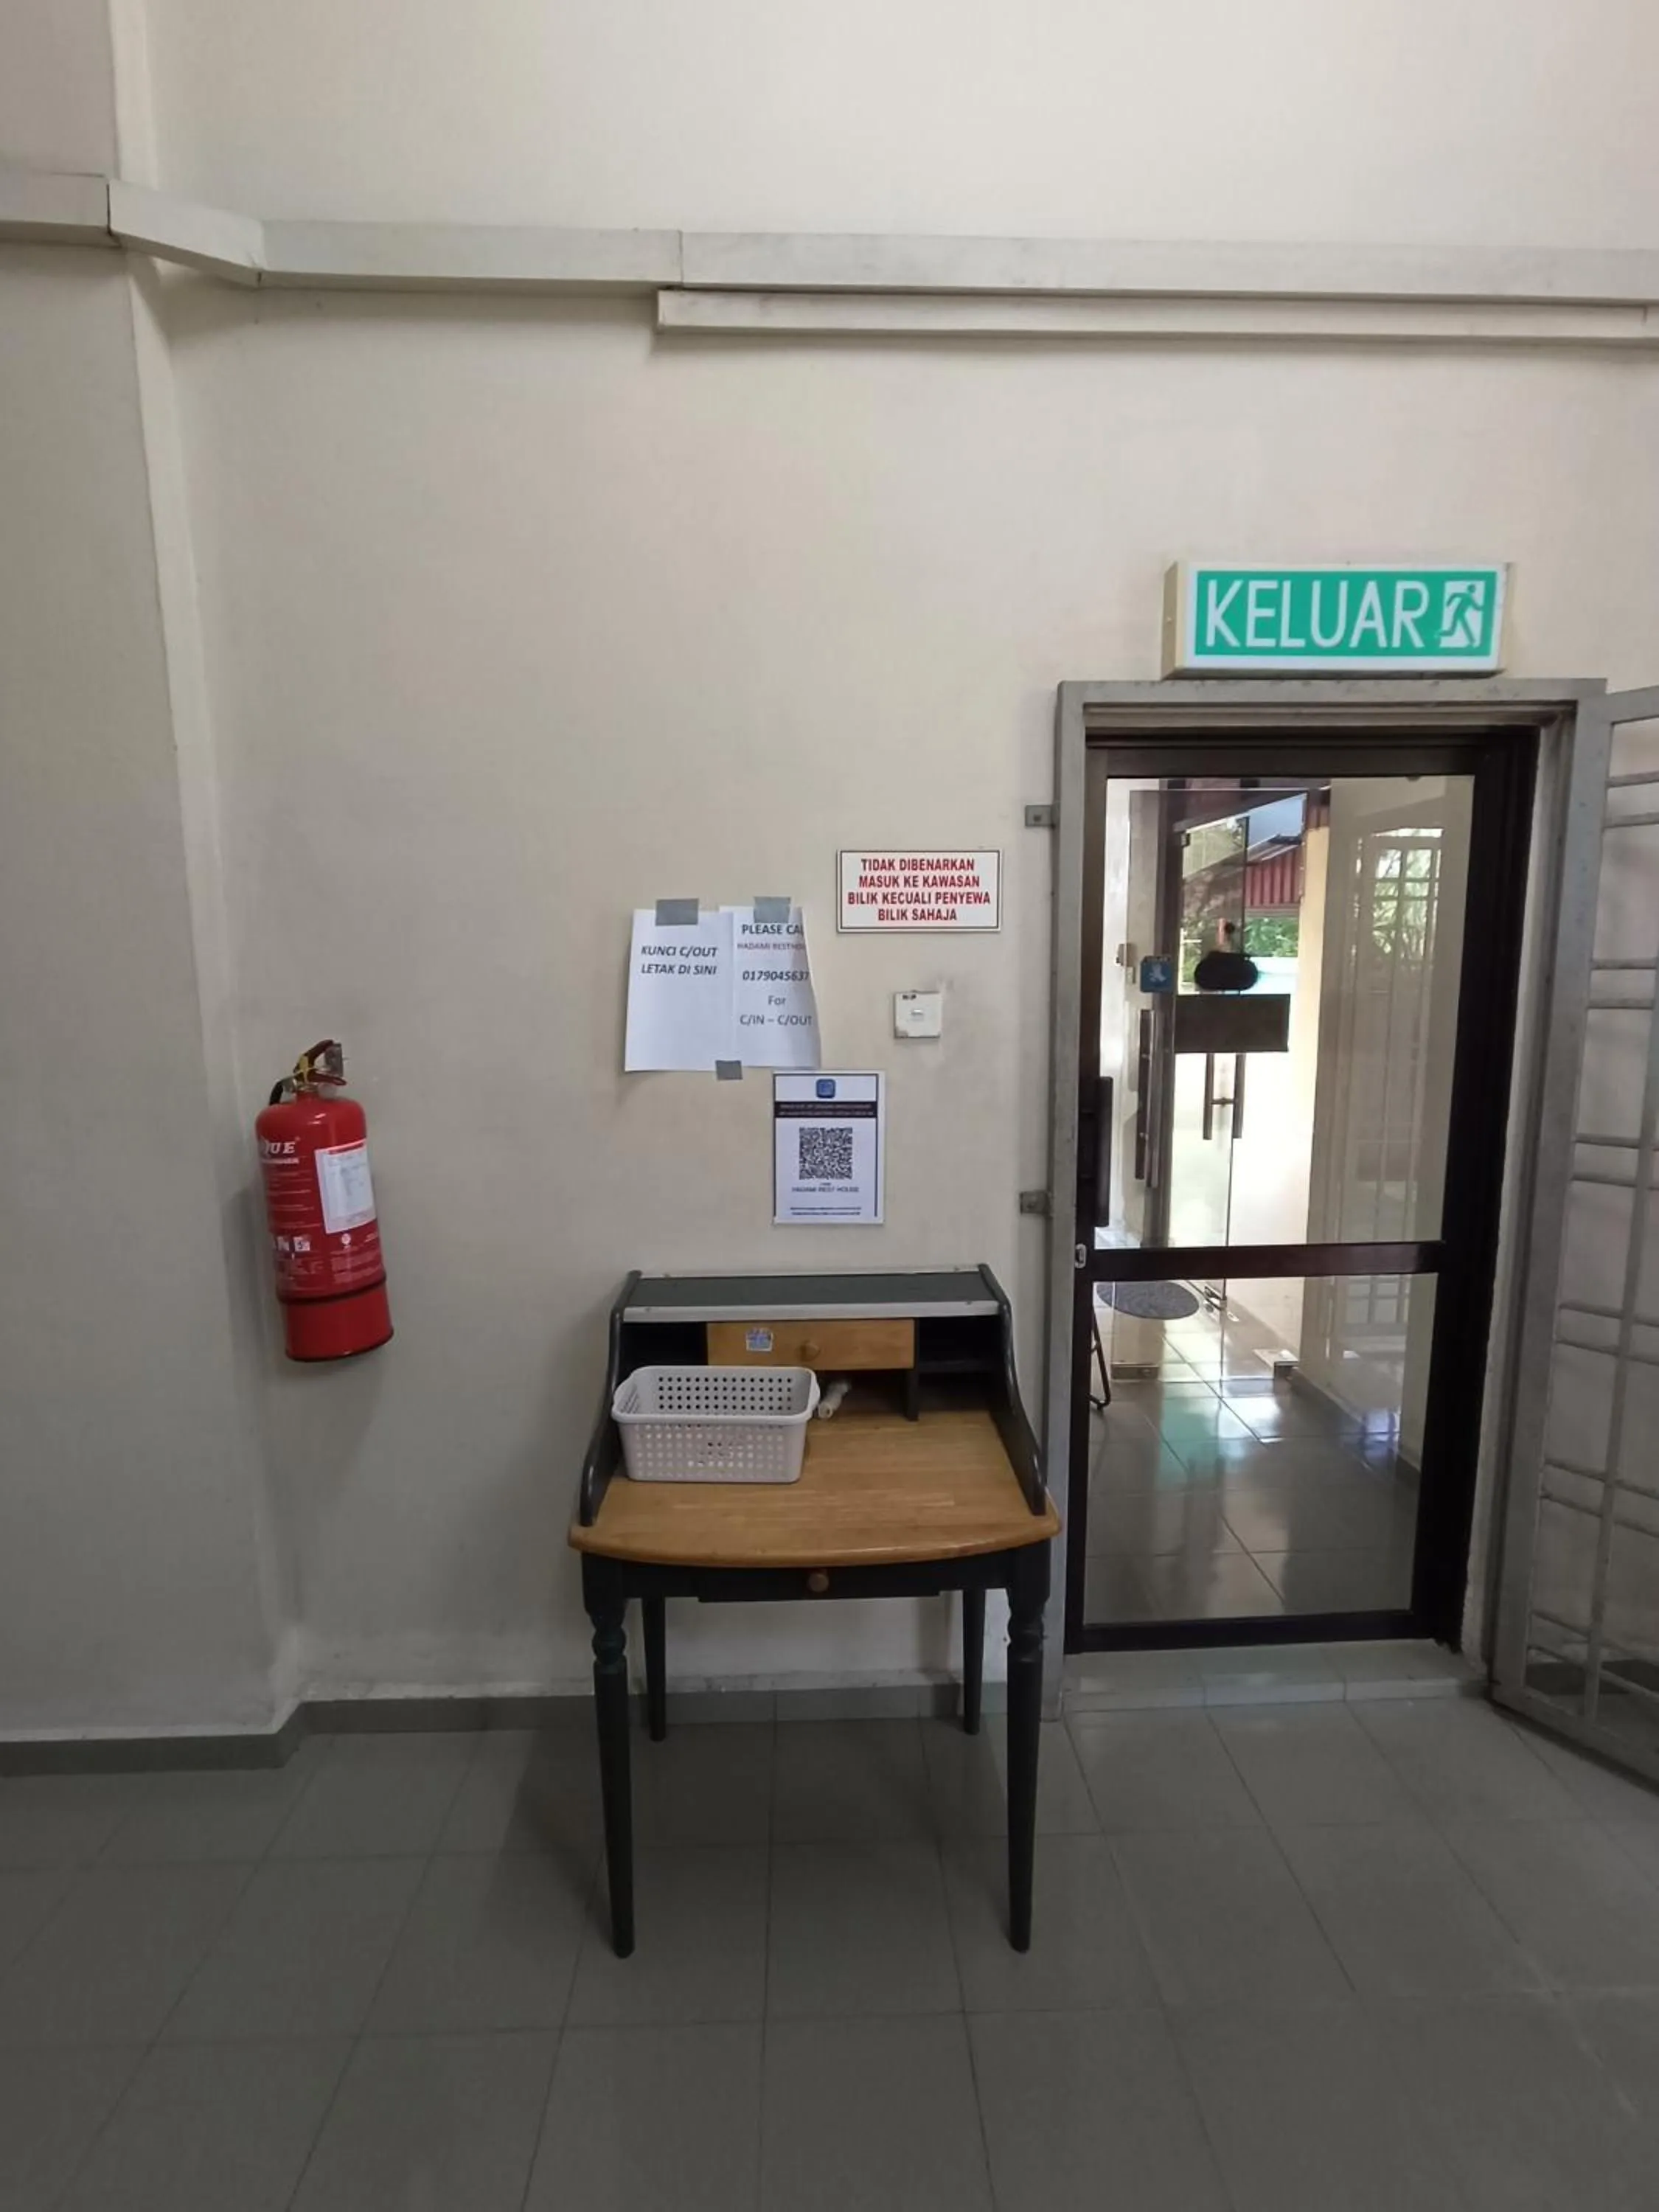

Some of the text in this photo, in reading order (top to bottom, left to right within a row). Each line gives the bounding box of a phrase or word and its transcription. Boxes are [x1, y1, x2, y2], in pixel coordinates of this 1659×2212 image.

[1206, 579, 1430, 648] KELUAR
[861, 858, 974, 871] TIDAK DIBENARKAN
[859, 875, 980, 888] MASUK KE KAWASAN
[847, 892, 991, 904] BILIK KECUALI PENYEWA
[878, 908, 957, 921] BILIK SAHAJA
[741, 924, 783, 935] PLEASE
[641, 945, 718, 959] KUNCI C/OUT
[641, 963, 717, 975] LETAK DI SINI
[768, 995, 786, 1006] For
[740, 1014, 765, 1026] C/IN
[777, 1014, 813, 1026] C/OUT
